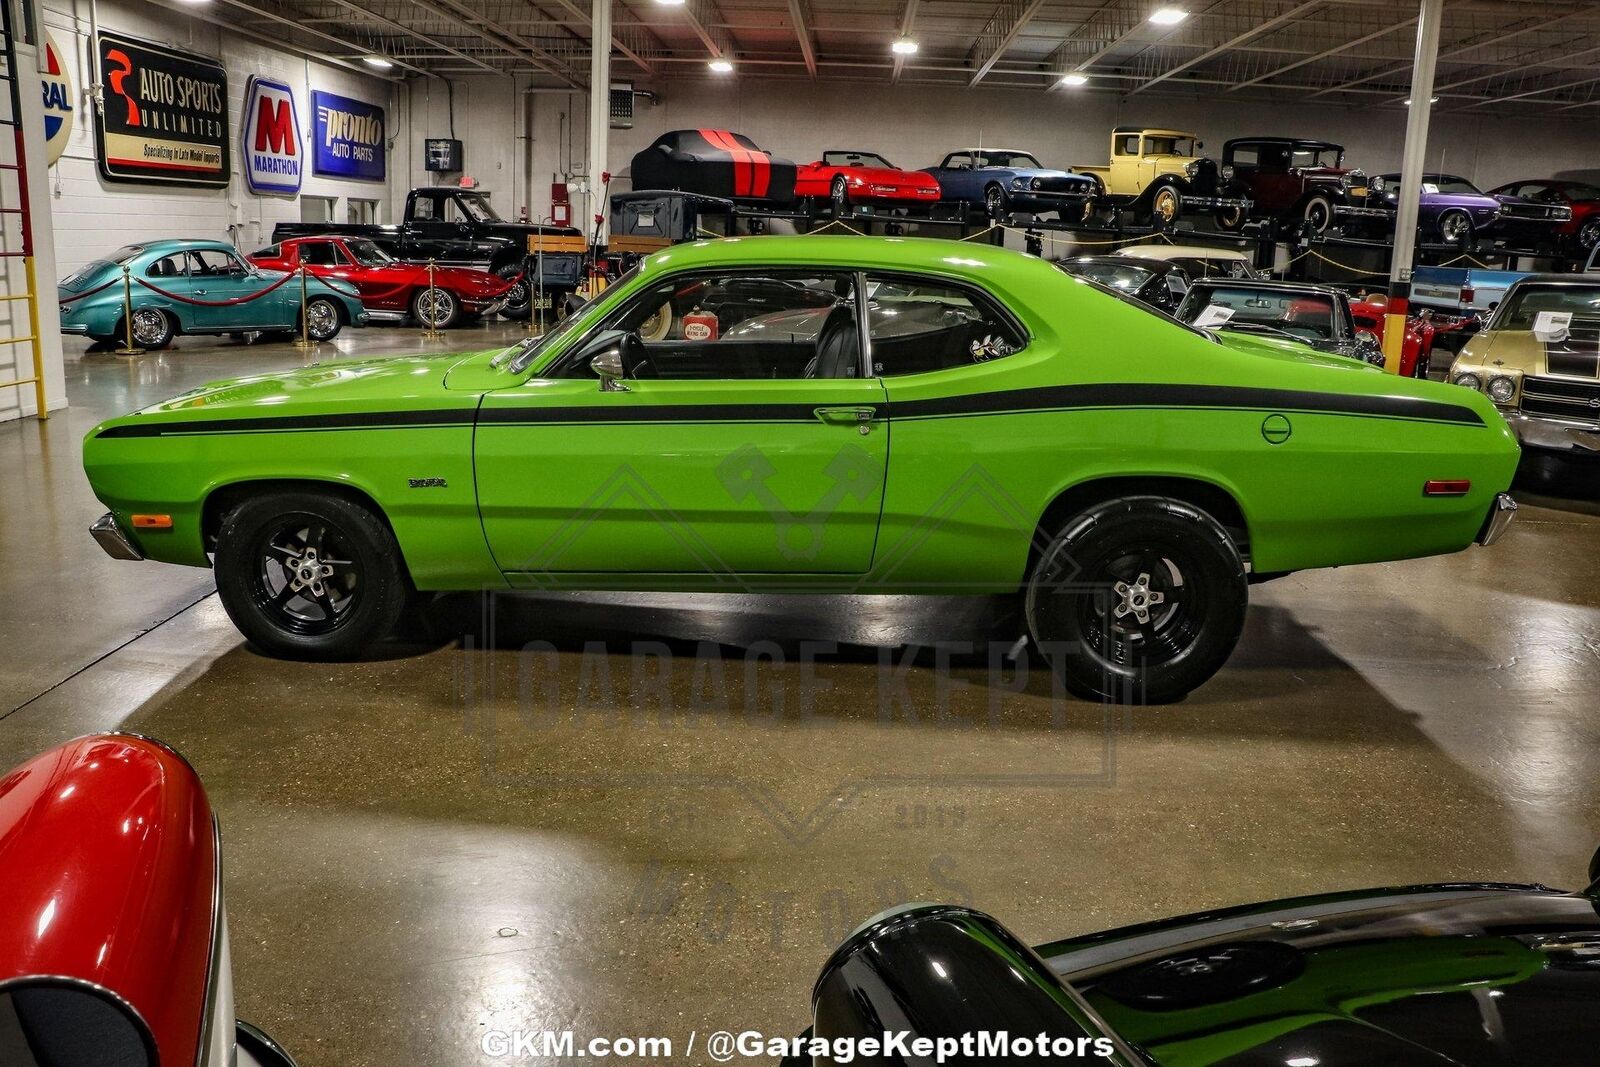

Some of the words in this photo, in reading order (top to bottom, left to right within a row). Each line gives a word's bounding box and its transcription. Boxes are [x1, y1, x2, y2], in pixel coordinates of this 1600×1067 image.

[140, 68, 174, 105] AUTO
[177, 76, 221, 114] SPORTS
[141, 109, 222, 138] UNLIMITED
[255, 95, 296, 156] M
[325, 108, 382, 147] pronto
[254, 155, 298, 176] MARATHON
[332, 142, 350, 158] AUTO
[353, 145, 373, 162] PARTS
